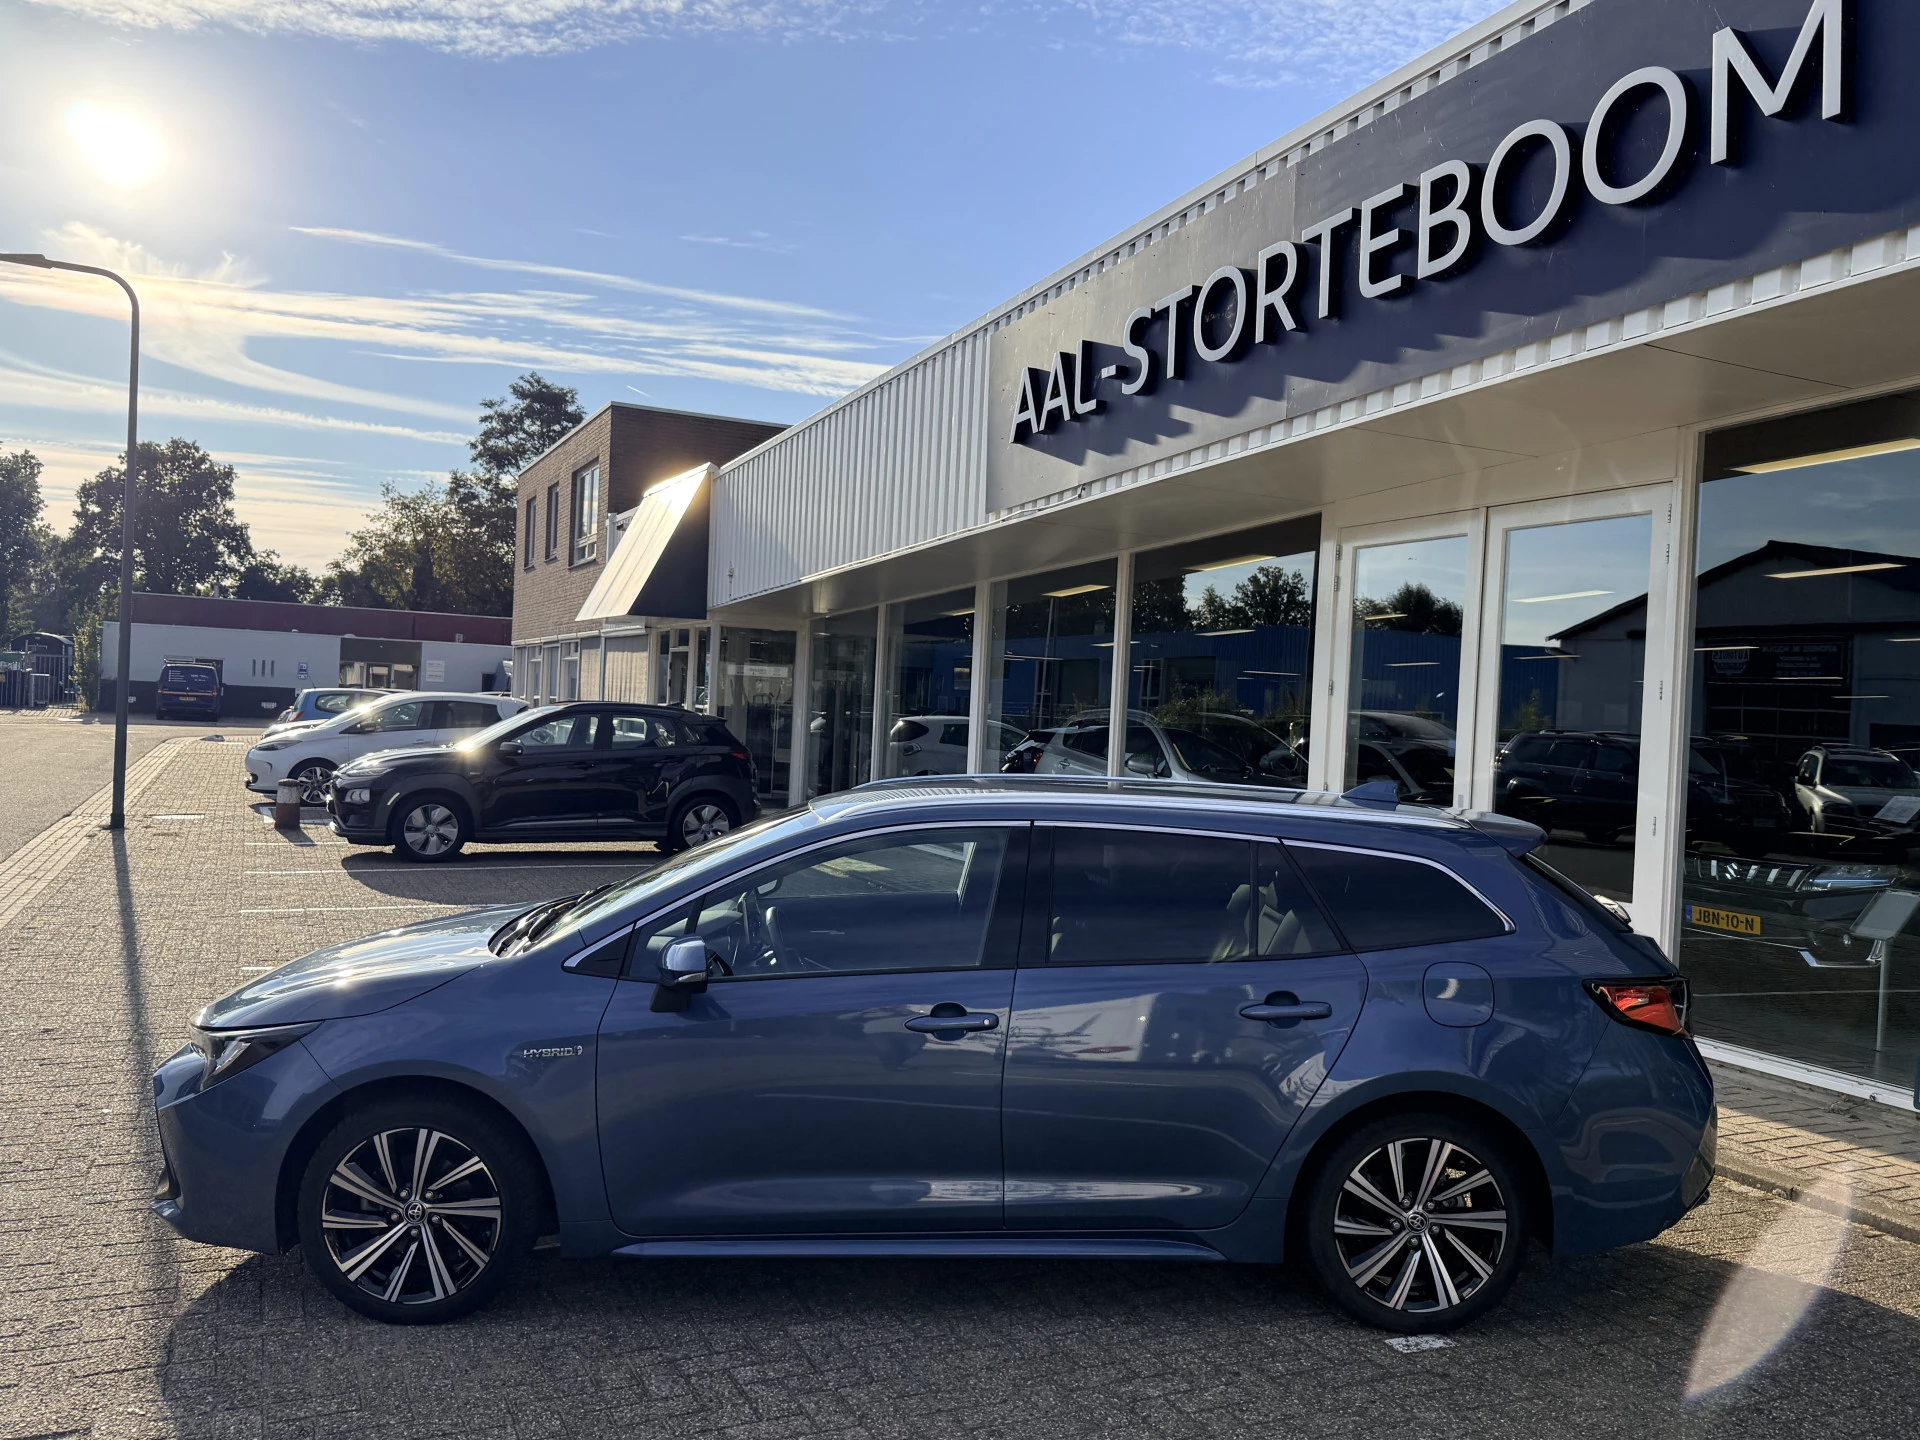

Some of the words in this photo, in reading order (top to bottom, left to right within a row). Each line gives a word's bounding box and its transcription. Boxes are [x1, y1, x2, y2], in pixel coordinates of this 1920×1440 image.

[1008, 0, 1845, 445] AAL-STORTEBOOM
[1695, 908, 1755, 932] JBN-10-N
[523, 1047, 573, 1058] HYBRID
